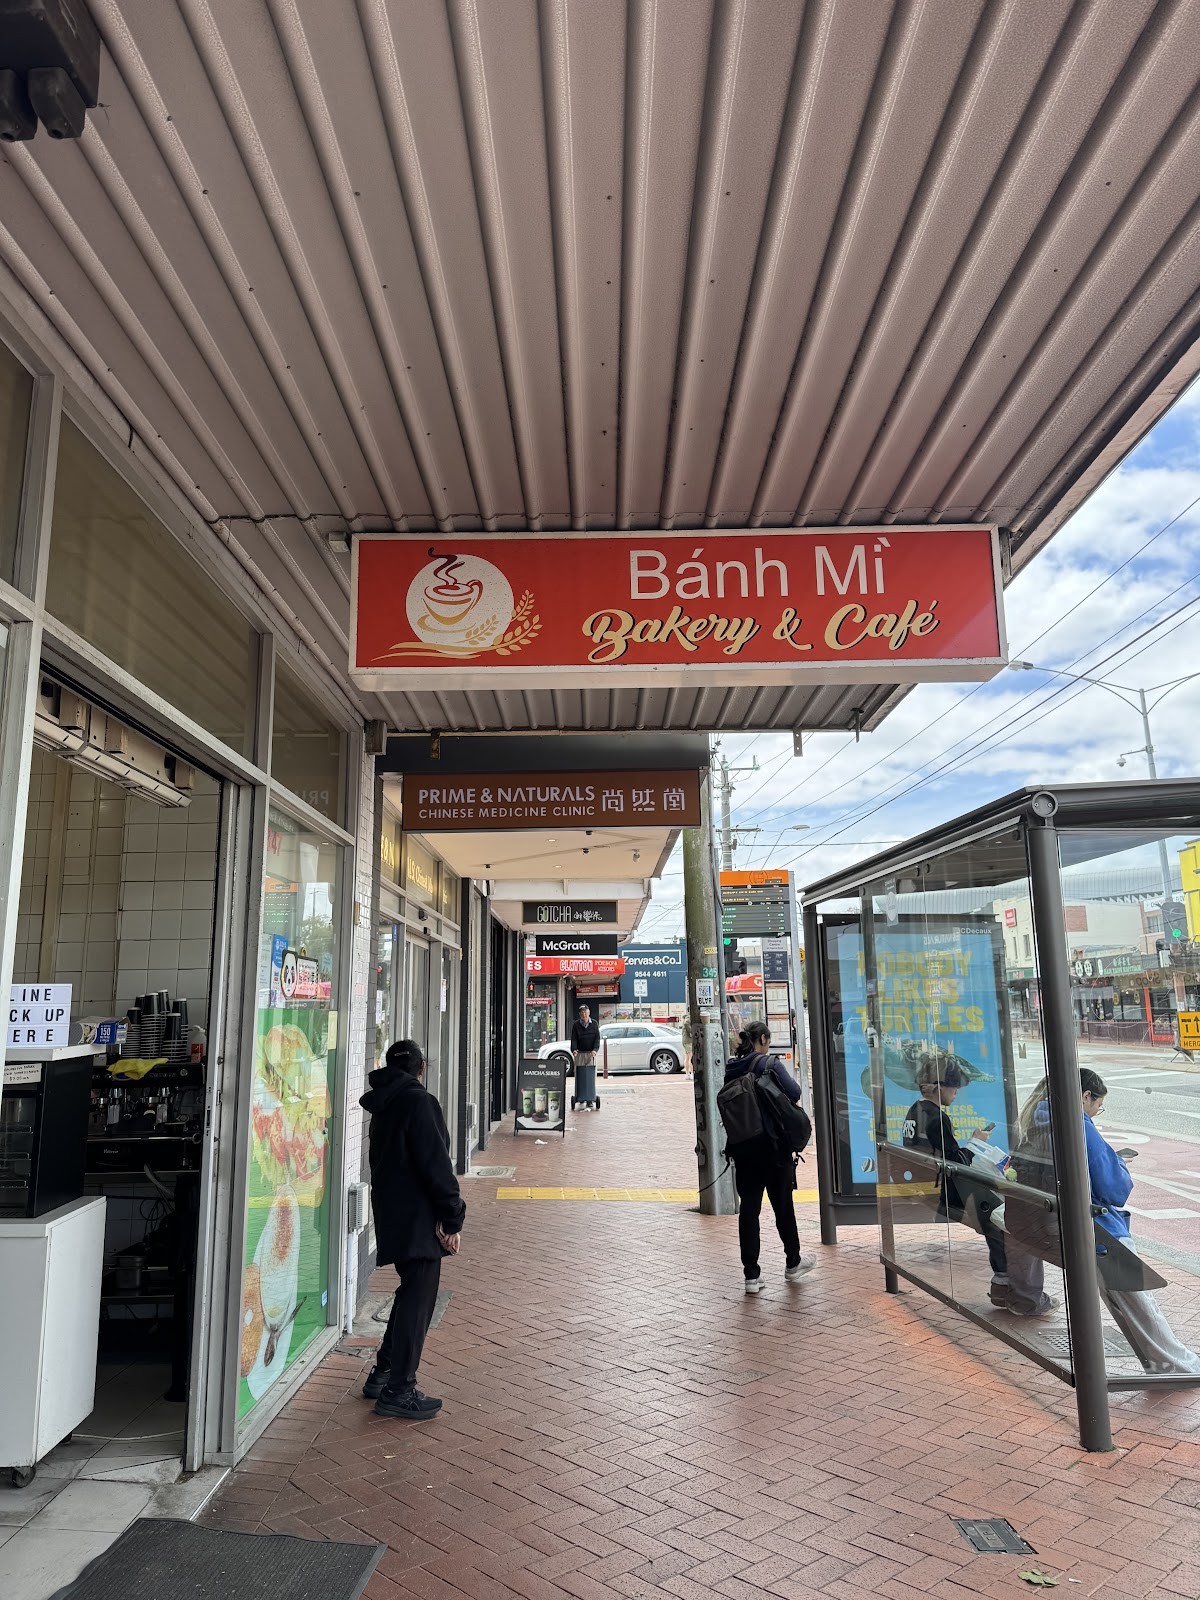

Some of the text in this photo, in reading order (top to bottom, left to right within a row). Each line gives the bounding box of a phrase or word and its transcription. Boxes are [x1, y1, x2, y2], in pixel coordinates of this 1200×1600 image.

[629, 537, 893, 600] Bánh Mì
[581, 598, 939, 664] Bakery & Café
[418, 785, 595, 804] PRIME & NATURALS
[418, 805, 595, 819] CHINESE MEDICINE CLINIC
[536, 905, 572, 922] GOTCHA
[542, 940, 590, 951] McGrath
[527, 960, 542, 970] ES
[559, 960, 594, 972] CLAYTON
[10, 988, 52, 1001] INE
[878, 978, 960, 1005] LIKES
[9, 1008, 65, 1022] CK UP
[855, 1006, 985, 1032] TURTLES
[13, 1029, 54, 1042] ERE
[100, 1027, 111, 1036] 150
